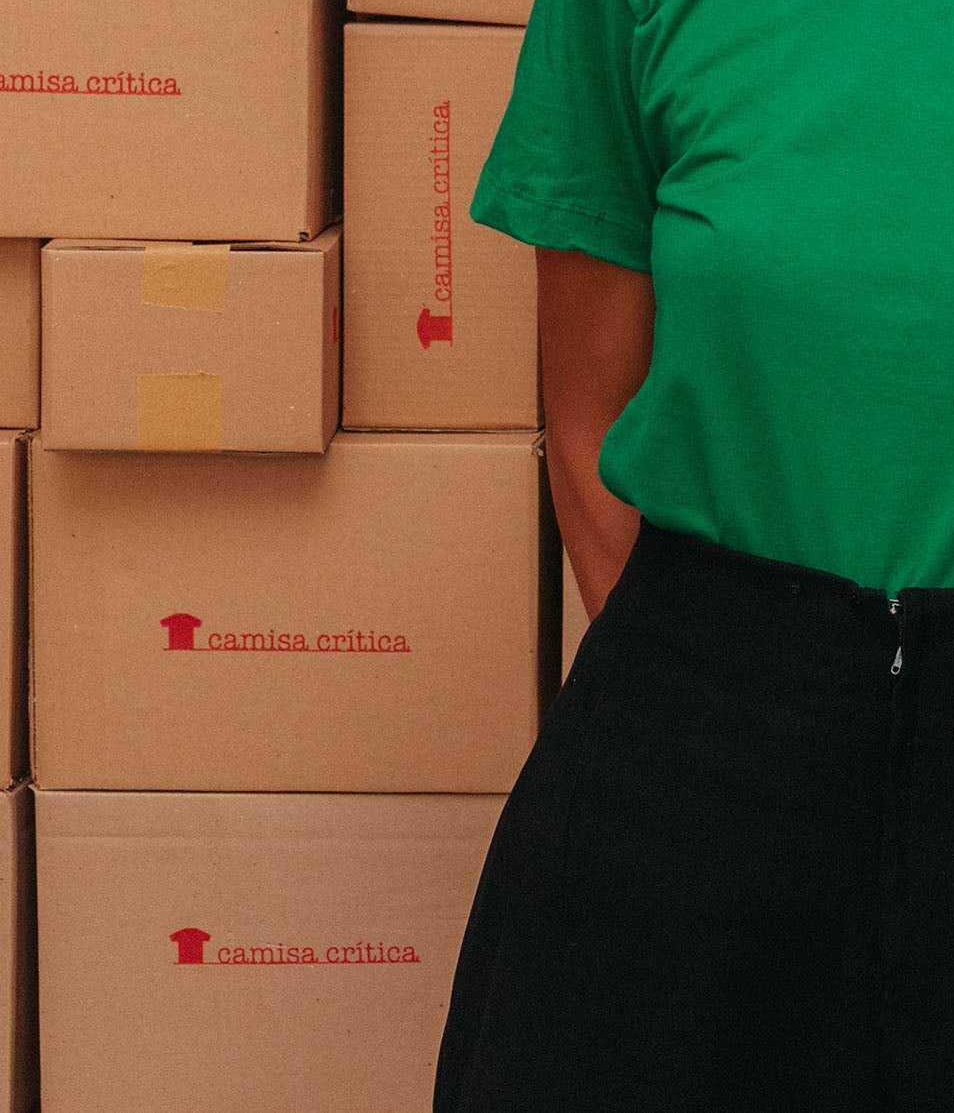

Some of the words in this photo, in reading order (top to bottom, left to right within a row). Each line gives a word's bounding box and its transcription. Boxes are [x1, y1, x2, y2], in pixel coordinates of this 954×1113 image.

[84, 71, 182, 96] crítica
[428, 100, 451, 197] crítica
[430, 199, 453, 304] camisa
[206, 630, 311, 653] camisa
[315, 629, 411, 653] crítica
[216, 944, 320, 965] camisa
[324, 942, 421, 965] crítica
